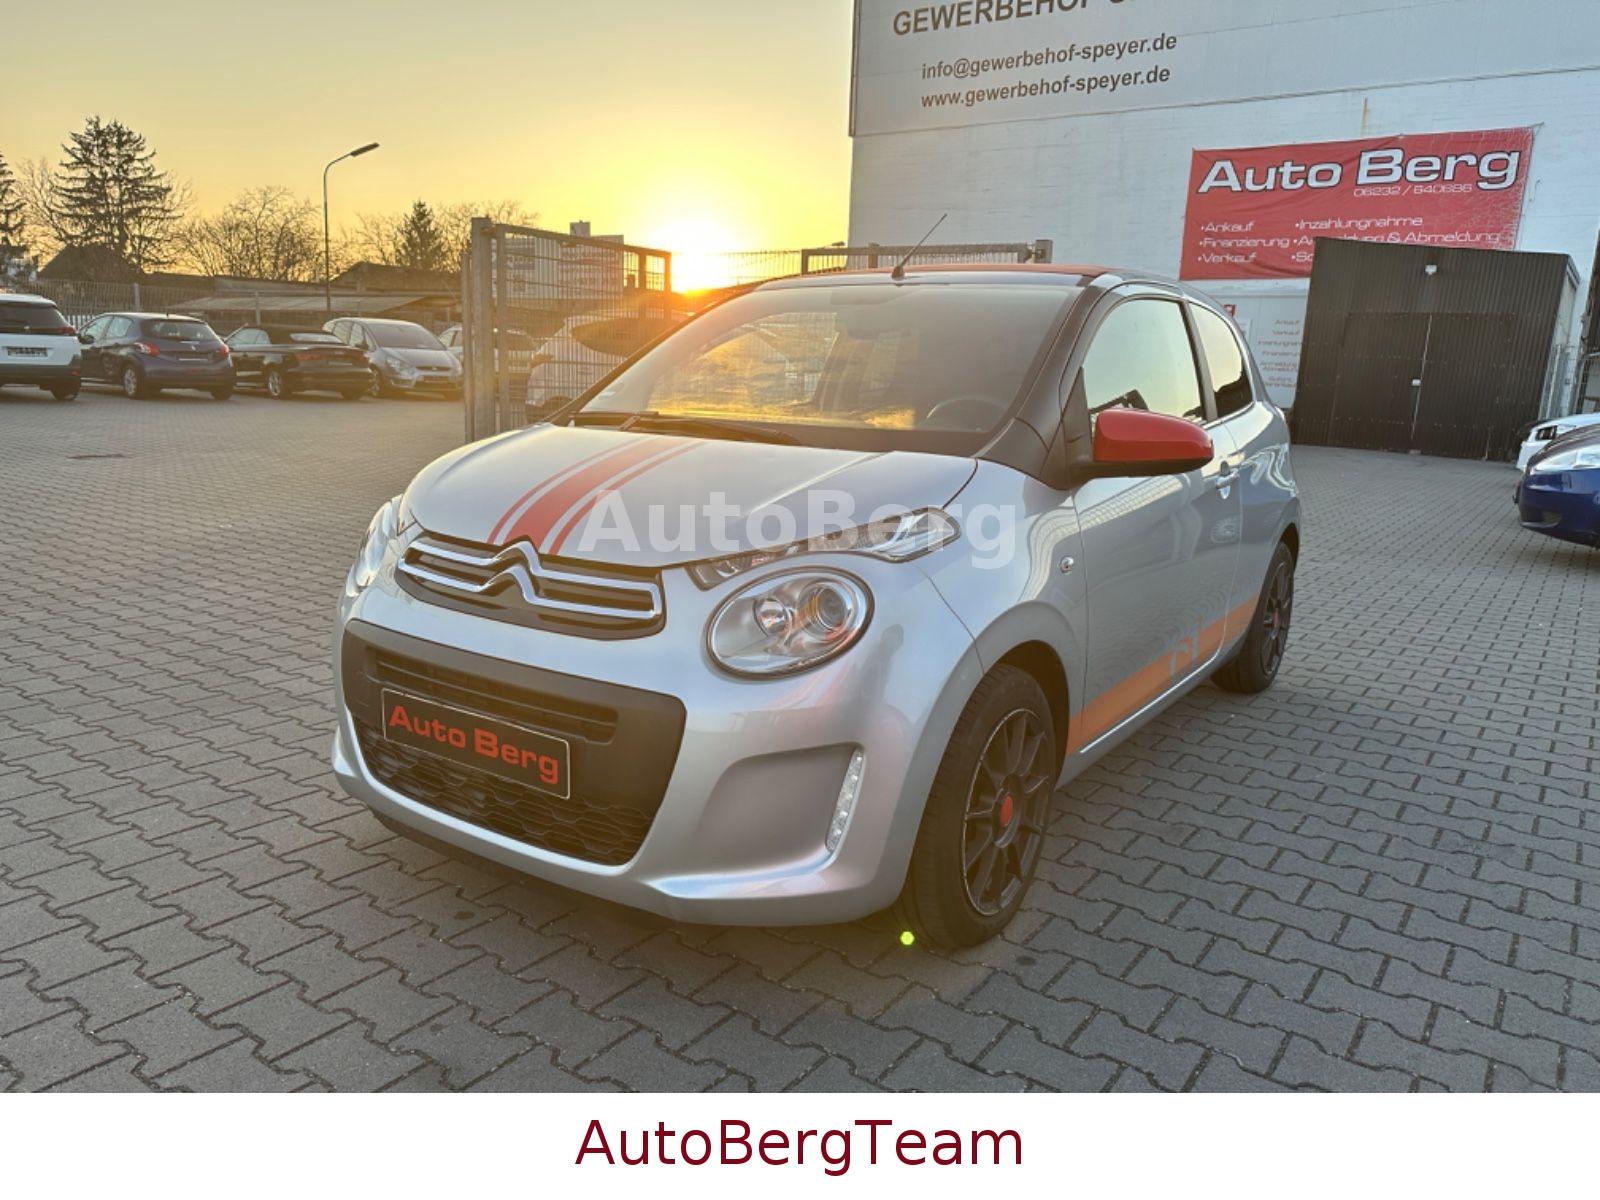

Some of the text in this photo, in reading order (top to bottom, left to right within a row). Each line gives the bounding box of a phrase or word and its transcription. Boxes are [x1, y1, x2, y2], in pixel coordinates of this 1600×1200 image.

[921, 32, 1178, 79] info@gewerbehof-speyer.de
[921, 65, 1170, 107] www.gewerbehof-speyer.de
[1198, 148, 1522, 193] Auto Berg
[1204, 220, 1255, 232] Ankauf
[1299, 216, 1423, 230] Inzahlungnahme
[1202, 236, 1290, 249] Finanzierung
[1404, 231, 1500, 244] Abmeldung
[1202, 252, 1257, 263] Verkauf
[389, 705, 560, 786] Auto Berg
